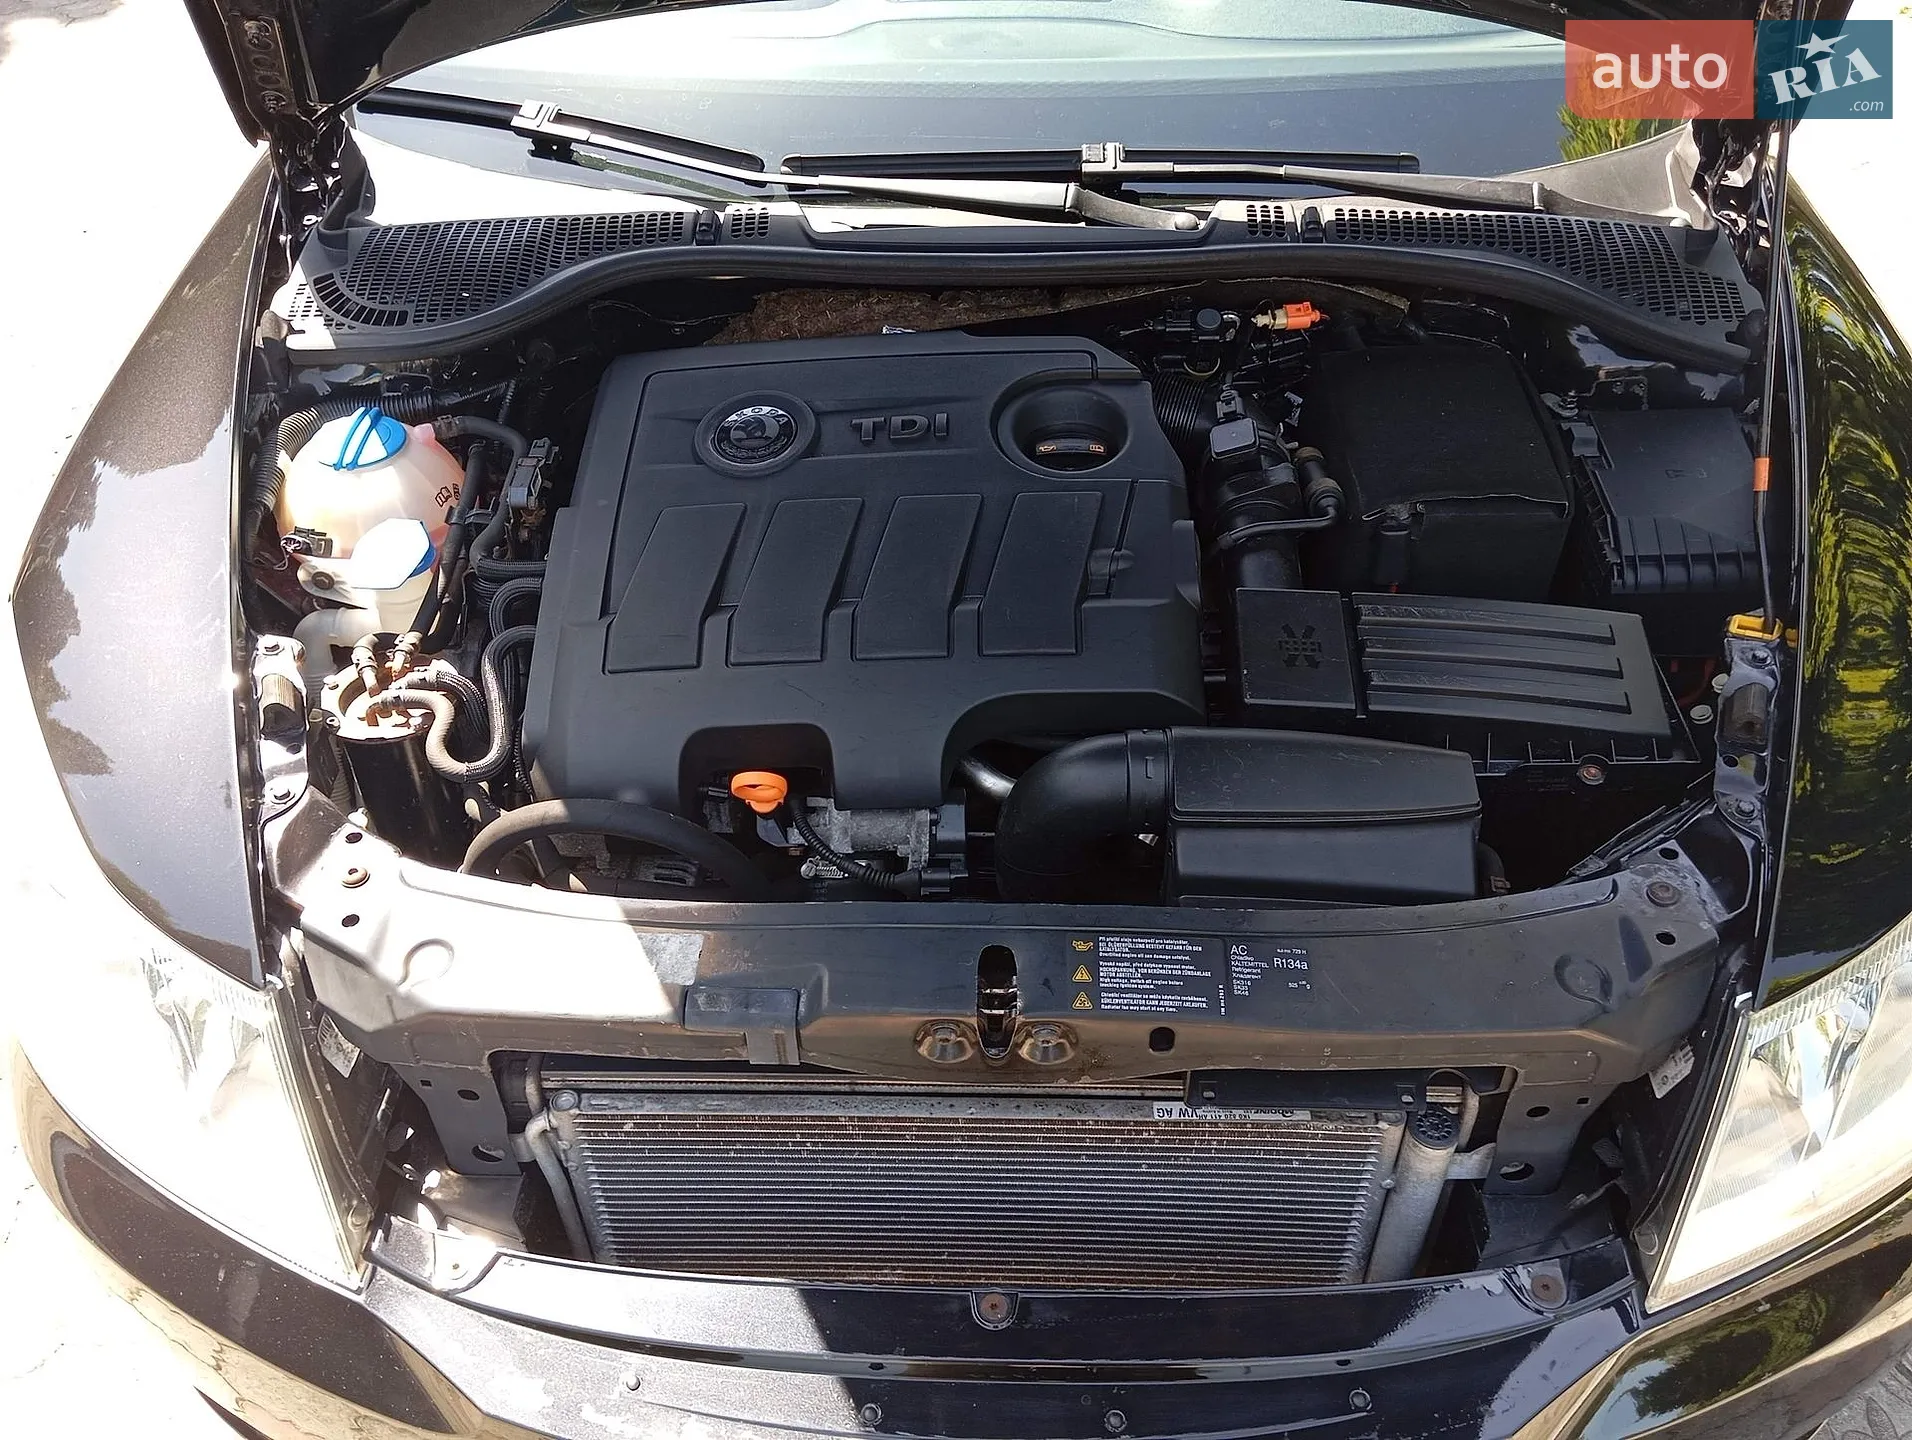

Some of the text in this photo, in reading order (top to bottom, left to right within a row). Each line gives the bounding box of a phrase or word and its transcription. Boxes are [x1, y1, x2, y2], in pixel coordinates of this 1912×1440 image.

[850, 412, 949, 442] TDI
[1230, 945, 1248, 956] AC
[1273, 957, 1309, 970] R134a
[1156, 1107, 1173, 1119] AG
[1178, 1107, 1199, 1118] VW
